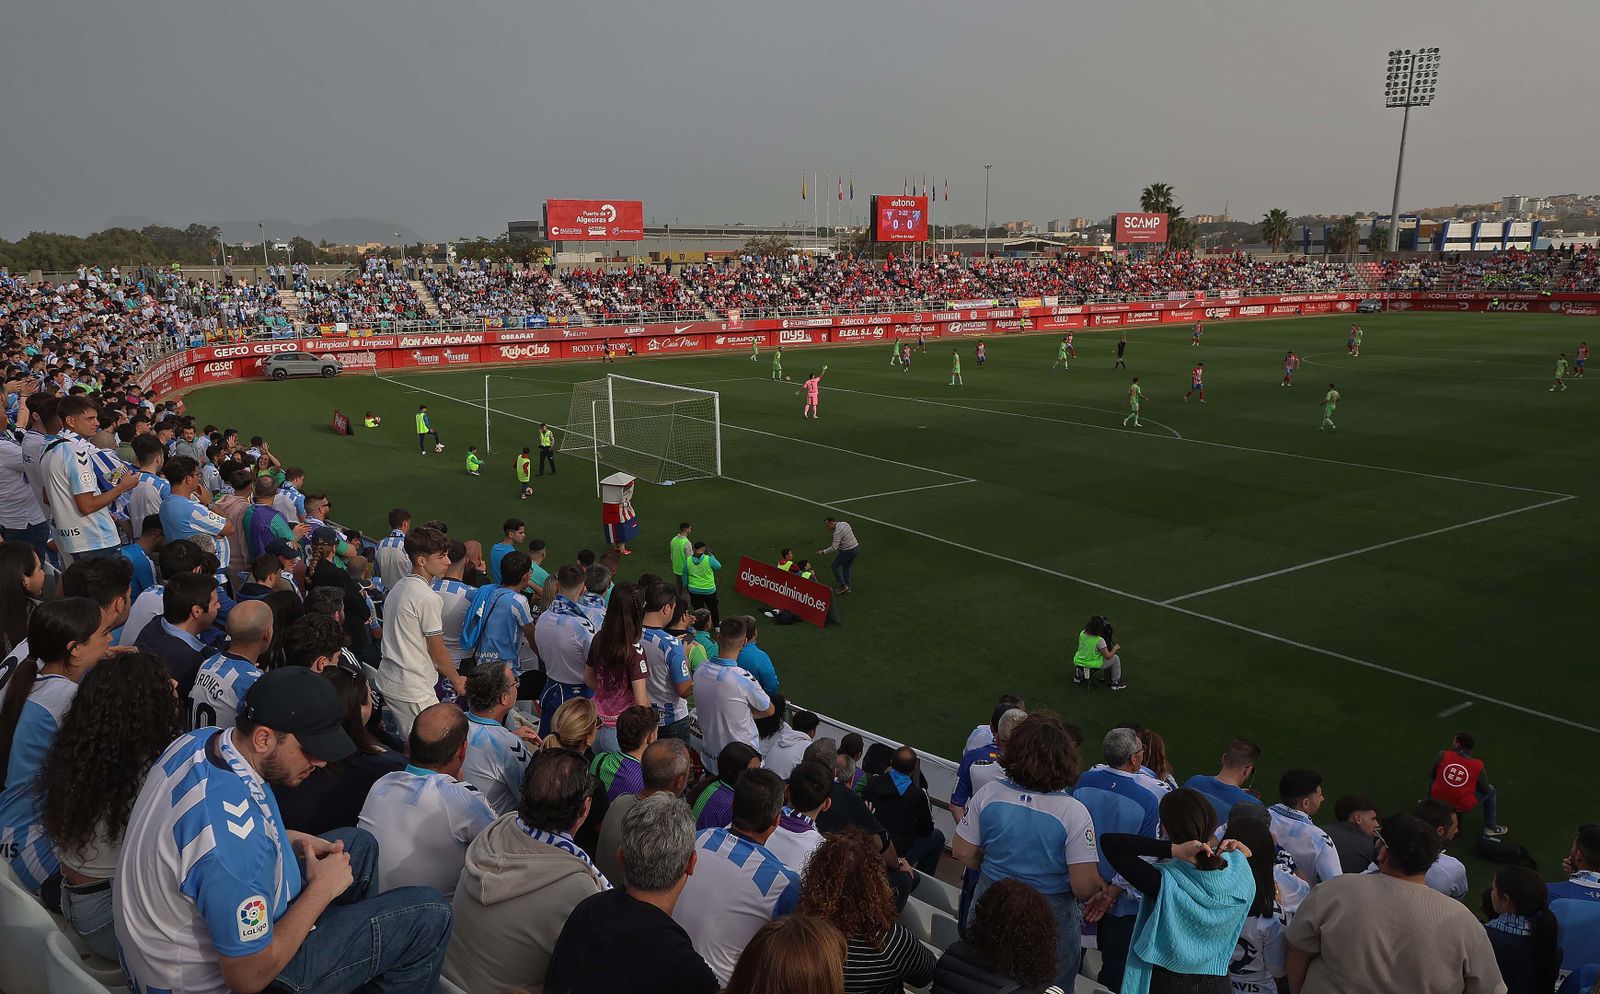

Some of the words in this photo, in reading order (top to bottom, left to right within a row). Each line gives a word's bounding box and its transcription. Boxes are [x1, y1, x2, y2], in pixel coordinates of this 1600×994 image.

[576, 216, 607, 224] Algeciras
[893, 219, 899, 229] 0
[907, 219, 913, 229] 0
[1124, 216, 1160, 229] SCAMP
[842, 317, 865, 326] Adecco
[868, 315, 892, 324] Adecco
[839, 328, 859, 338] ELEAL
[873, 325, 884, 335] 40
[315, 340, 350, 351] Limpiasol
[361, 338, 394, 349] Limpiasol
[400, 336, 421, 347] AON
[422, 335, 442, 346] AON
[443, 334, 463, 345] AON
[464, 333, 483, 344] AON
[214, 346, 249, 357] GEFCO
[253, 343, 298, 354] GEFCO
[572, 344, 595, 353] BODY
[209, 360, 235, 372] caser
[741, 567, 826, 612] algecirasalminuto.es
[194, 673, 224, 700] RONES
[242, 922, 267, 937] LaLiga
